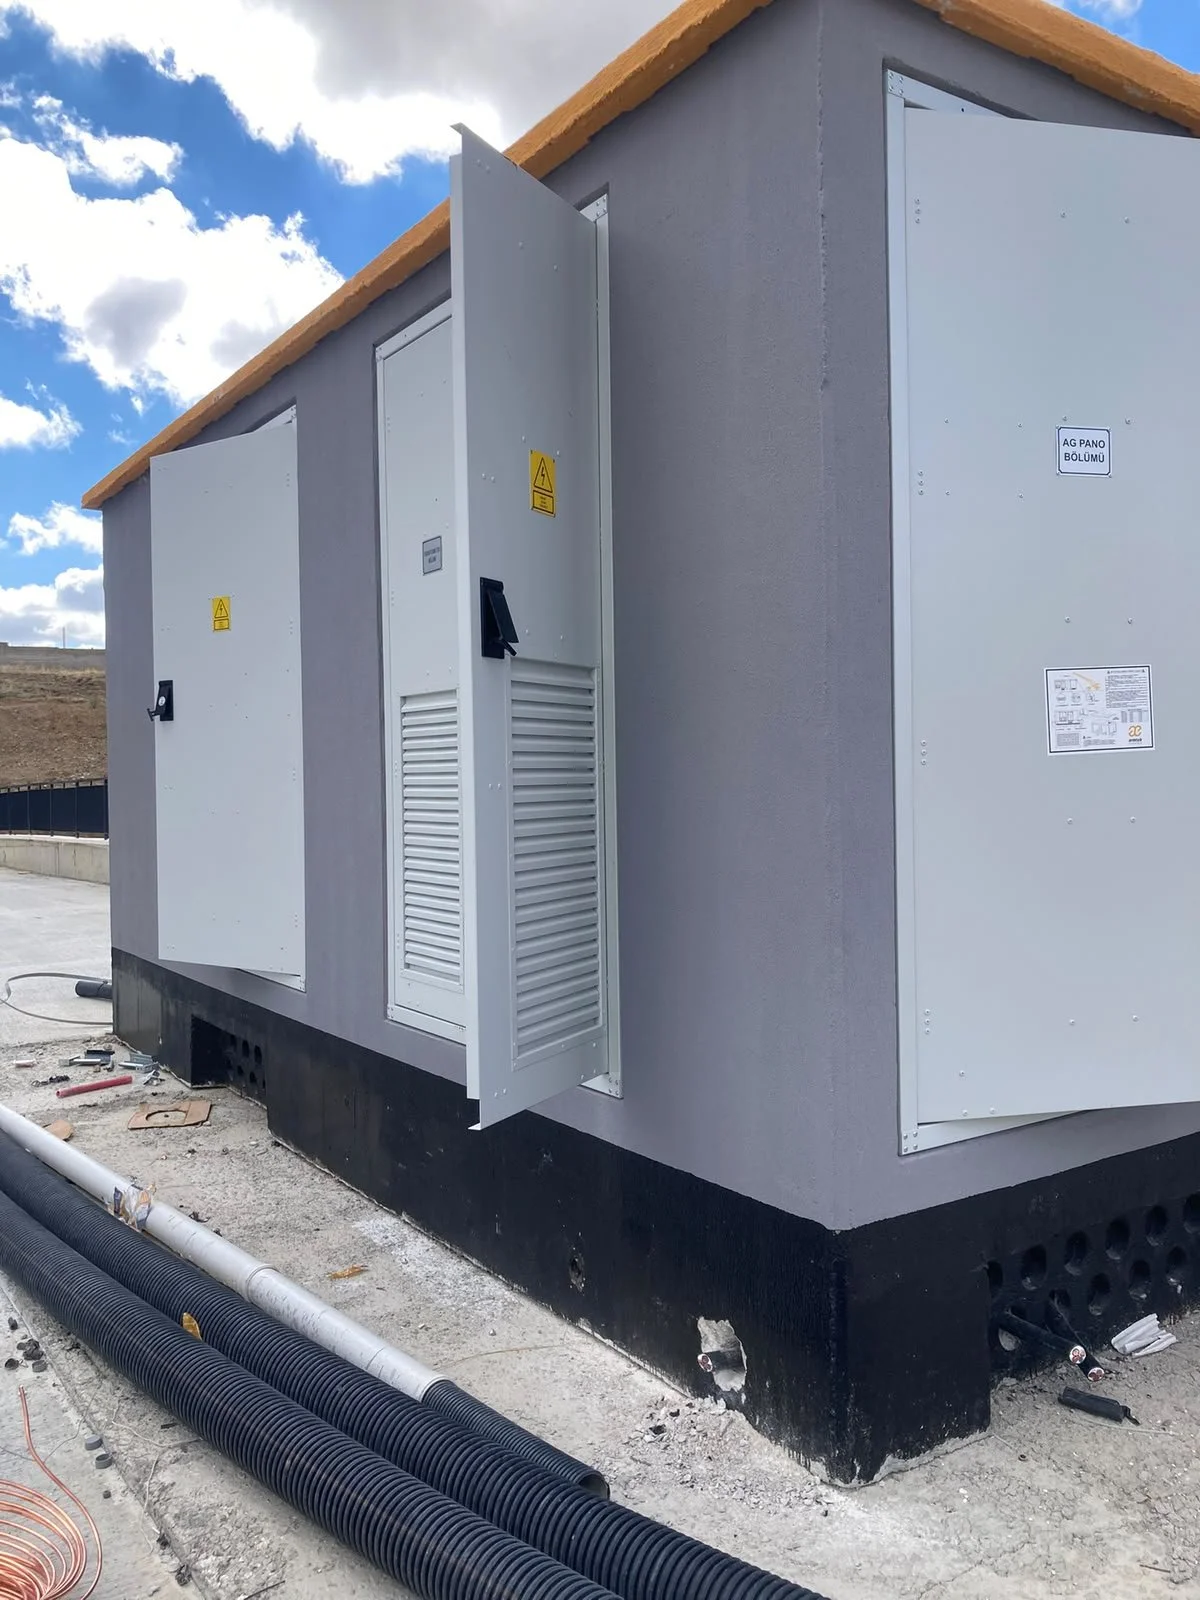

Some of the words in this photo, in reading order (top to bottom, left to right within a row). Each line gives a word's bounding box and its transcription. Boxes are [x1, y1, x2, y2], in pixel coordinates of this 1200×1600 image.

[1063, 438, 1077, 447] AG
[1080, 439, 1105, 448] PANO
[1064, 451, 1105, 463] BÖLÜMÜ
